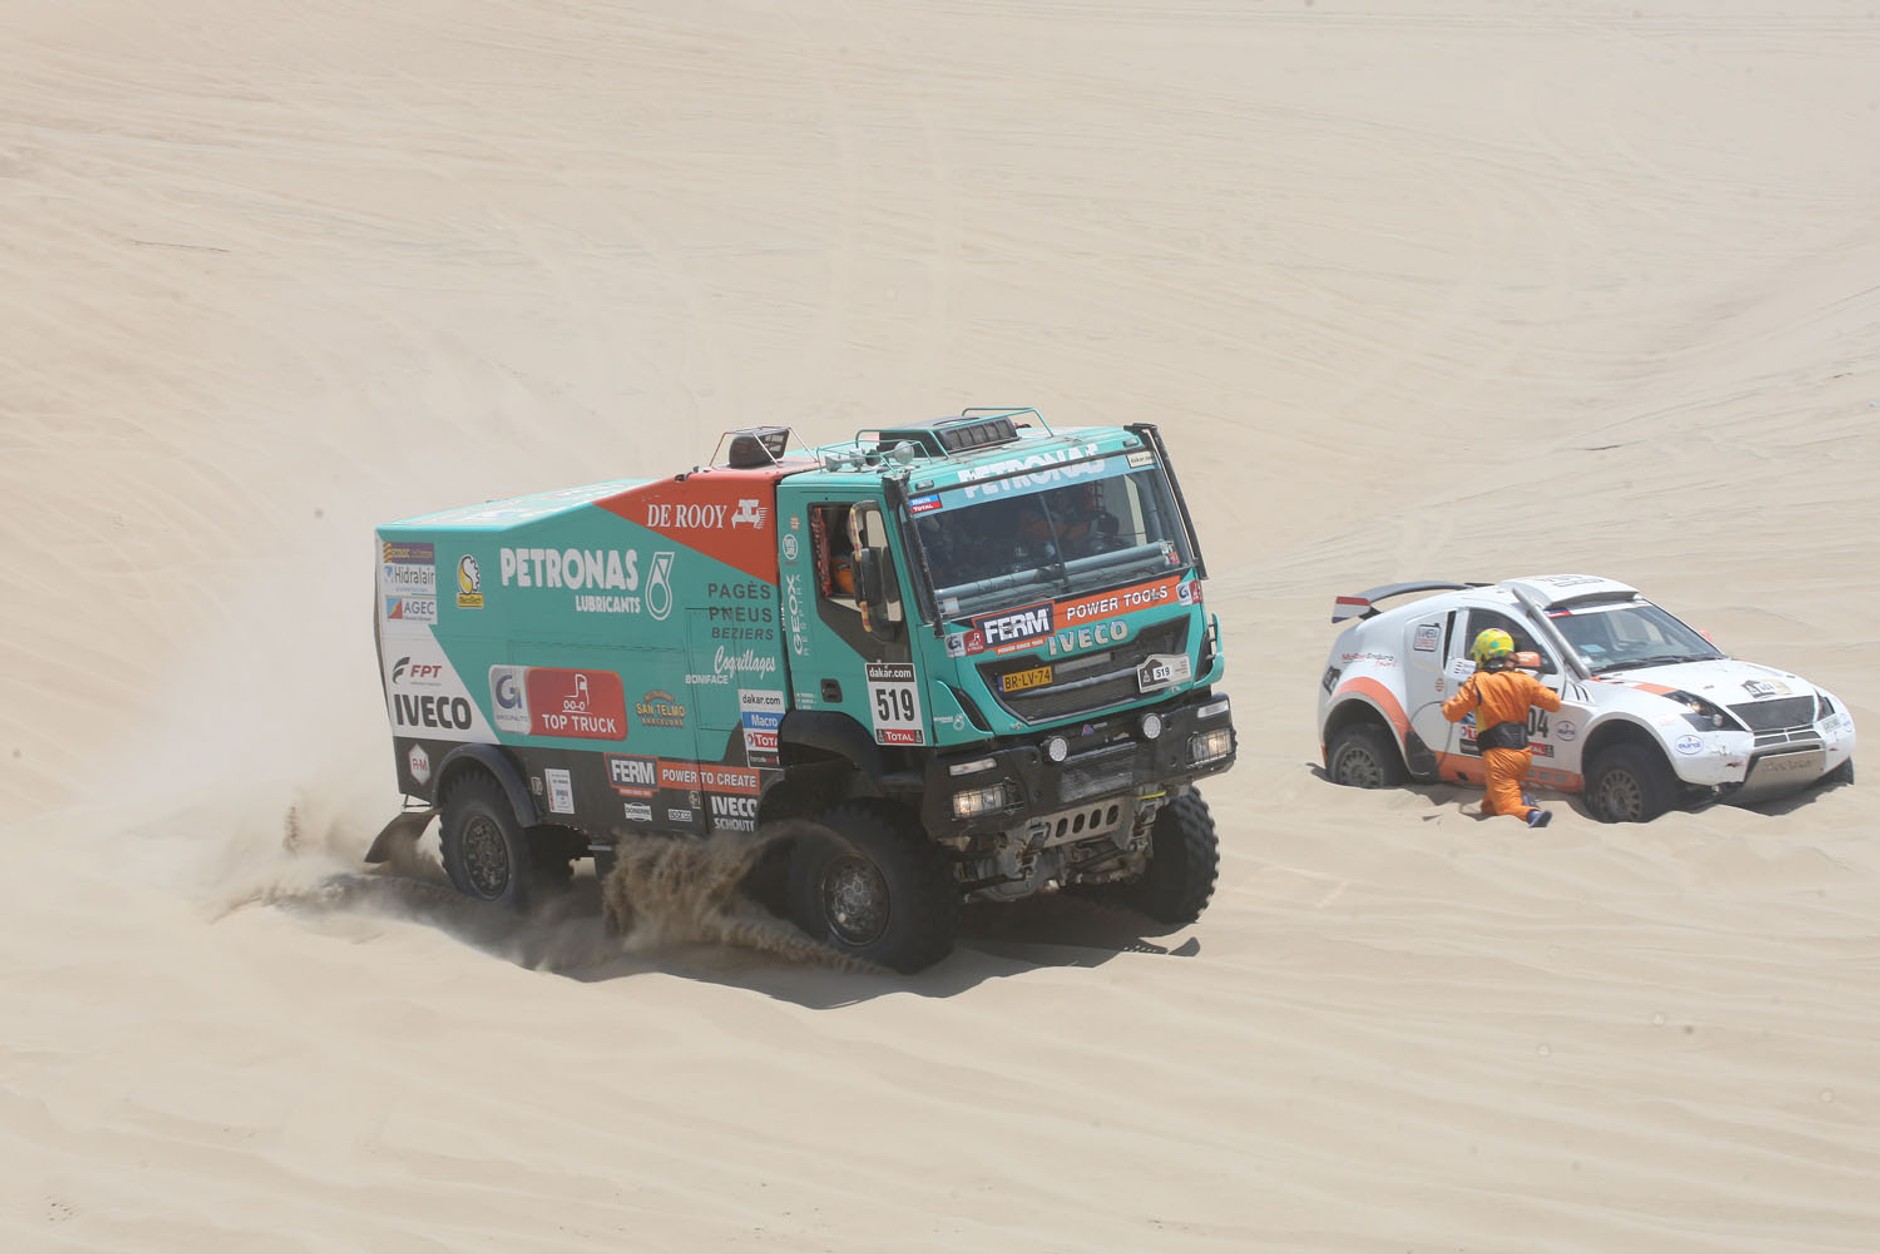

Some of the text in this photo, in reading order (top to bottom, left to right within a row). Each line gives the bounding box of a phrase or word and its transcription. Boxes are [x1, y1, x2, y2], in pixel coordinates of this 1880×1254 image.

[957, 443, 1105, 498] PETRONAS
[647, 504, 727, 528] DE ROOY
[500, 548, 639, 591] PETRONAS
[403, 602, 434, 614] AGEC
[575, 595, 641, 614] LUBRICANTS
[1066, 586, 1169, 621] POWER TOOLS
[709, 606, 773, 623] PNEUS
[785, 574, 803, 655] GEOX
[984, 609, 1049, 644] FERM
[1049, 620, 1128, 656] IVECO
[410, 665, 442, 678] FPT
[714, 645, 776, 680] Coquillages
[1155, 666, 1171, 678] 519
[685, 674, 729, 684] BONIFACE
[867, 668, 912, 680] dakar.com
[1004, 669, 1050, 690] BR-LV-74
[742, 694, 781, 705] dakar.com
[876, 689, 915, 722] 519
[394, 694, 472, 730] IVECO
[636, 702, 686, 718] SAN TELMO
[542, 714, 617, 733] TOP TRUCK
[751, 714, 778, 727] Macro
[1527, 706, 1549, 738] 04
[757, 736, 777, 746] TOT
[885, 732, 914, 741] TOTAL
[611, 759, 655, 784] FERM
[662, 769, 756, 788] POWER TO CREATE
